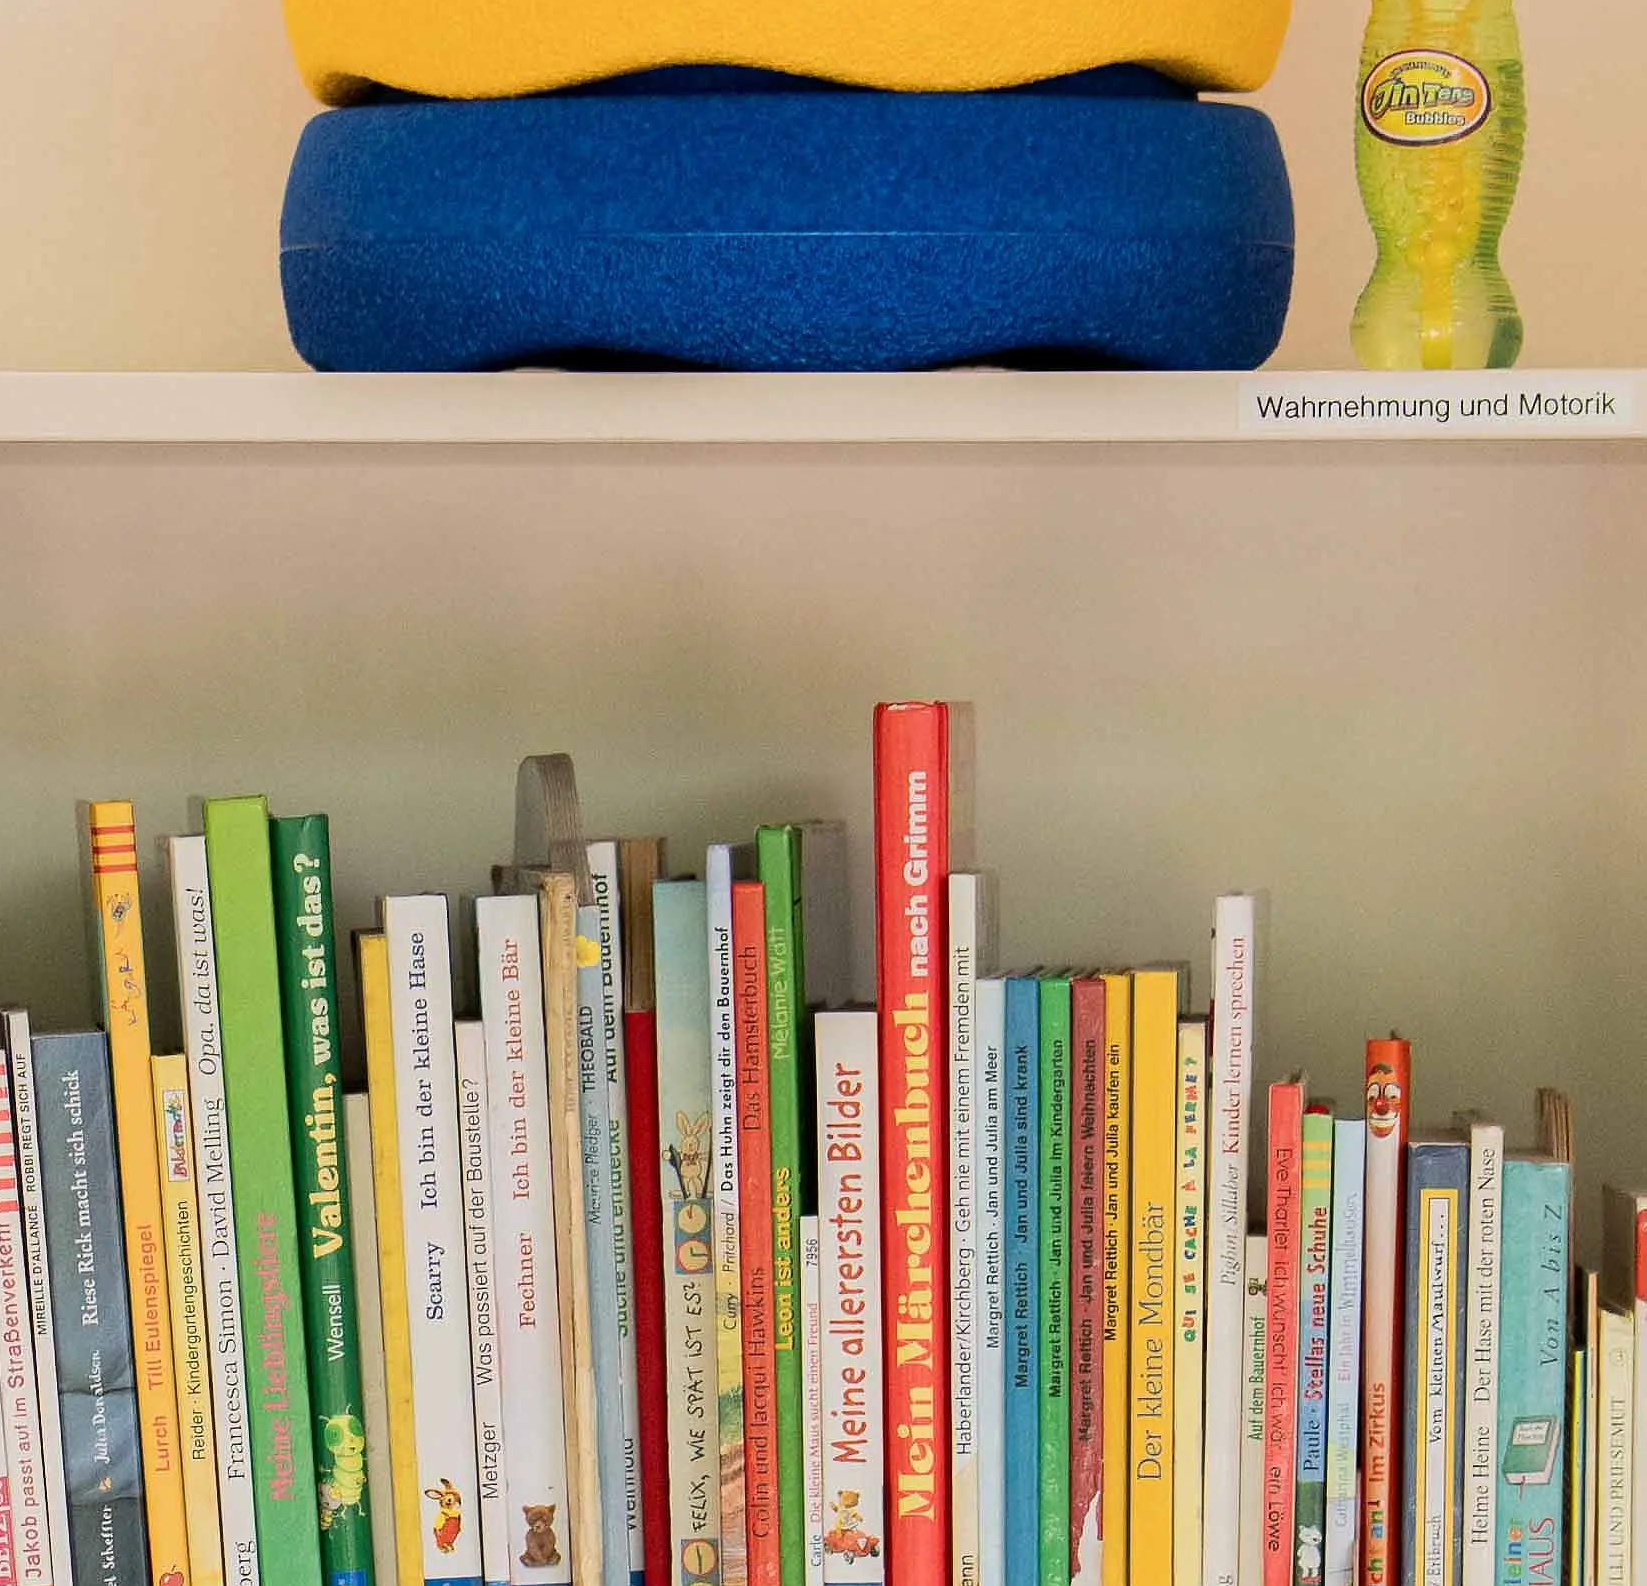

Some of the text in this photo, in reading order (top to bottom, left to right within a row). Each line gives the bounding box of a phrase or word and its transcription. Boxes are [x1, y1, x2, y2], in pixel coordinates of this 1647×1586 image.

[1405, 109, 1466, 126] Bubbles
[1257, 390, 1617, 424] Wahrnehmung und Motorik
[61, 1070, 100, 1326] Riese Rick macht sich schick
[406, 932, 447, 1321] Scarry Ich bin der kleine Hase
[499, 938, 537, 1329] Fechner Ich bin der kleine Bär
[892, 771, 936, 1521] Mein Märchenbuch nach Grimm
[136, 1223, 173, 1473] Lurch Till Eulenspiegel
[174, 1200, 207, 1461] Reider Kindergartengeschichten
[201, 1097, 247, 1480] Francesca Simon David Melling
[321, 1284, 347, 1362] Wensell
[462, 1077, 501, 1500] Metzger Was passiert auf der Baustelle?
[771, 1167, 794, 1351] Leon ist anders
[825, 1063, 869, 1464] Meine allerersten Bilder
[1136, 1201, 1165, 1480] Der kleine Mondbär
[1305, 1206, 1328, 1401] Stellas neue Schuhe
[1471, 1148, 1496, 1544] Helme Heine Der Hase mit der roten Nase
[1301, 1419, 1323, 1472] Paule
